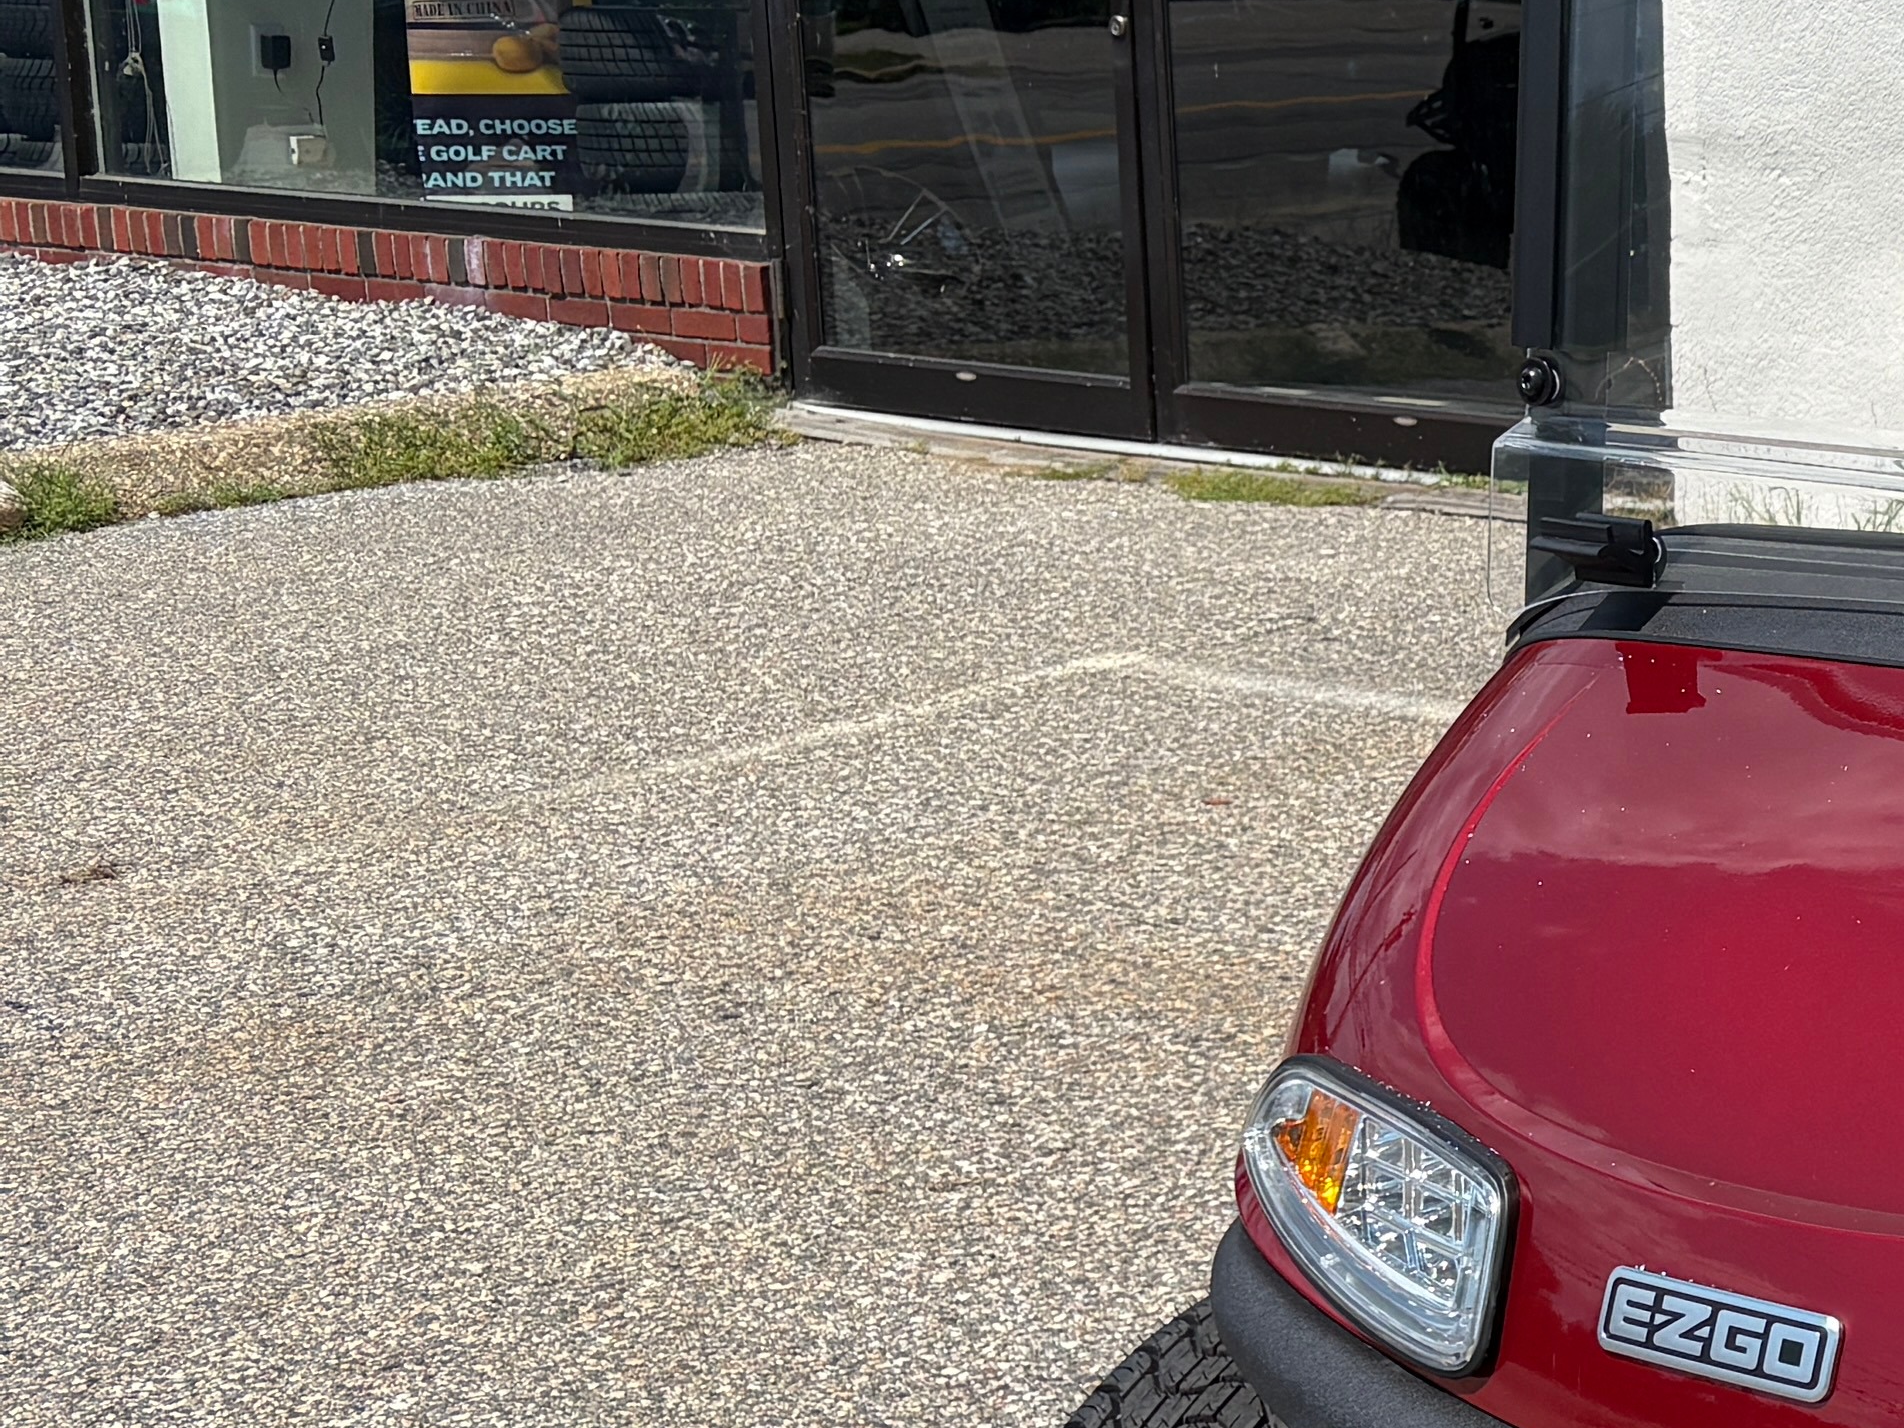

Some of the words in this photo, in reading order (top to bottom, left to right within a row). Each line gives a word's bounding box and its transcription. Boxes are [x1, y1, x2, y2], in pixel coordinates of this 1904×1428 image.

[414, 3, 444, 17] MADE
[447, 2, 463, 16] IN
[466, 0, 512, 15] CHINA
[413, 119, 474, 136] EAD,
[479, 119, 578, 135] CHOOSE
[430, 145, 496, 162] GOLF
[502, 145, 567, 162] CART
[488, 171, 555, 188] THAT
[1608, 1283, 1821, 1384] EZGO
